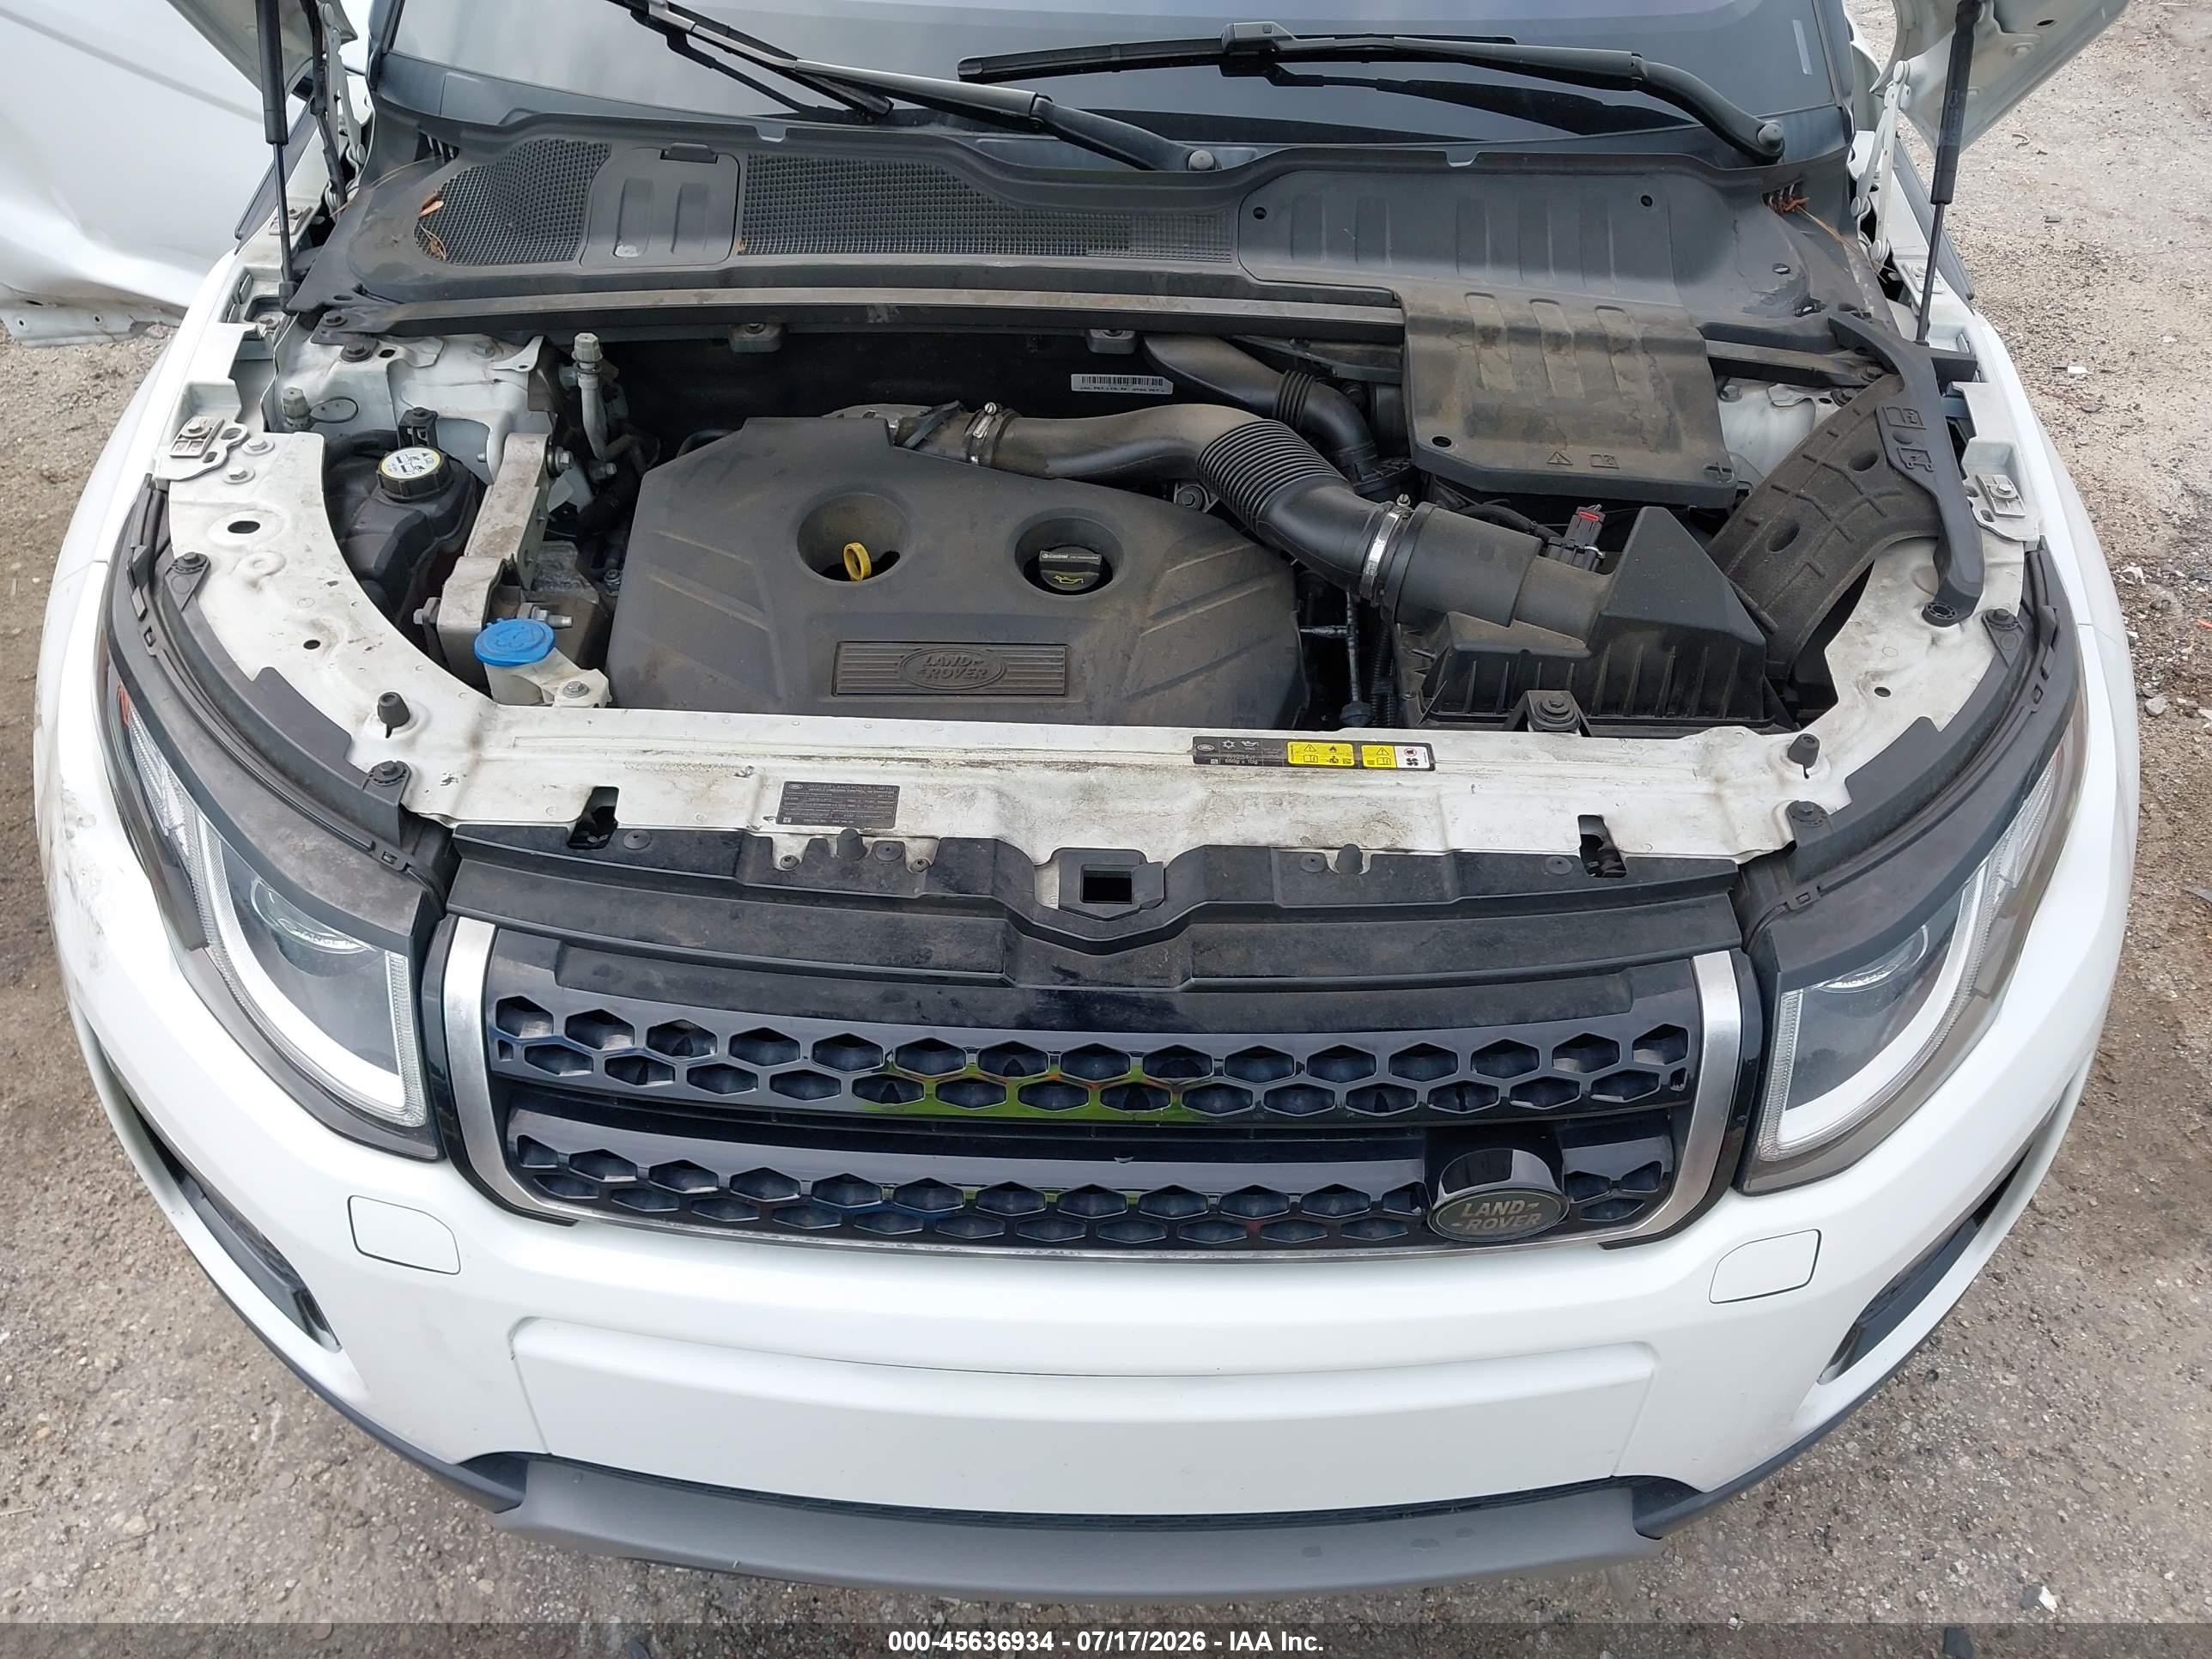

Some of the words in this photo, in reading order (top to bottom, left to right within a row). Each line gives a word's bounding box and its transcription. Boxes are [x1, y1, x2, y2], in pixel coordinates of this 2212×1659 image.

[922, 654, 974, 667] LAND
[926, 667, 988, 680] ROVER
[1461, 1200, 1525, 1218] LAND
[1466, 1212, 1542, 1231] ROVER
